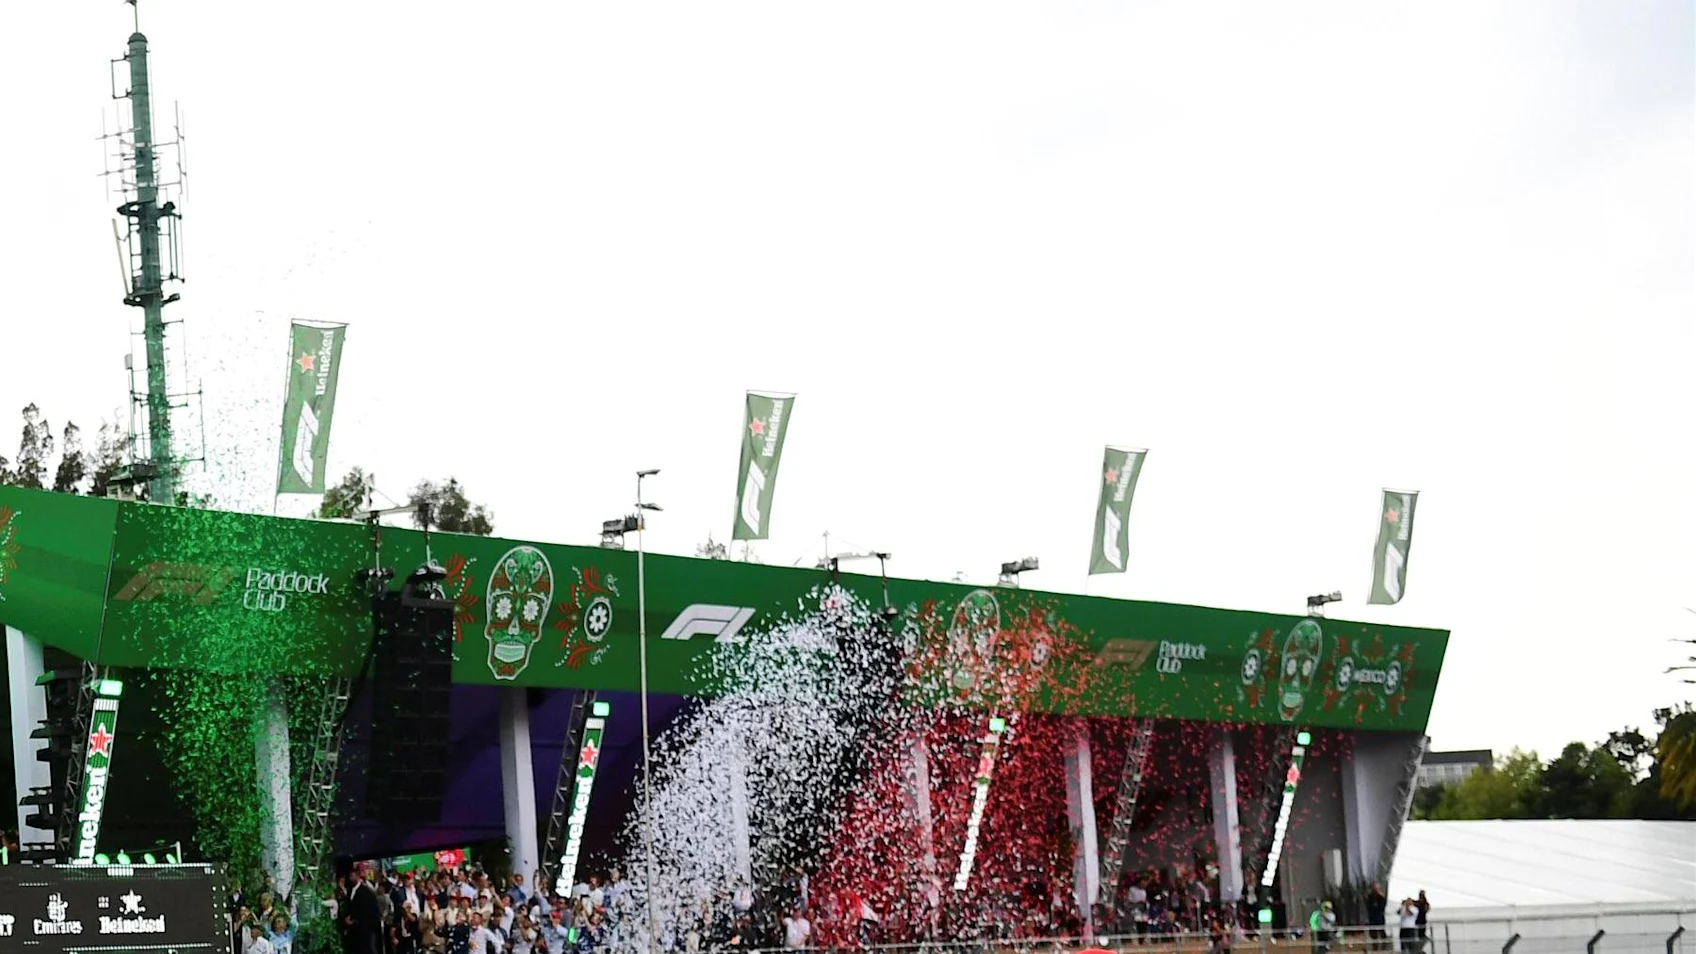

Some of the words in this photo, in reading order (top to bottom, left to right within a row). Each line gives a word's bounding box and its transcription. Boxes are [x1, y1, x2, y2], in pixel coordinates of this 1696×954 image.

[315, 330, 335, 396] Heineken
[245, 566, 330, 595] Paddock
[243, 588, 286, 612] Club
